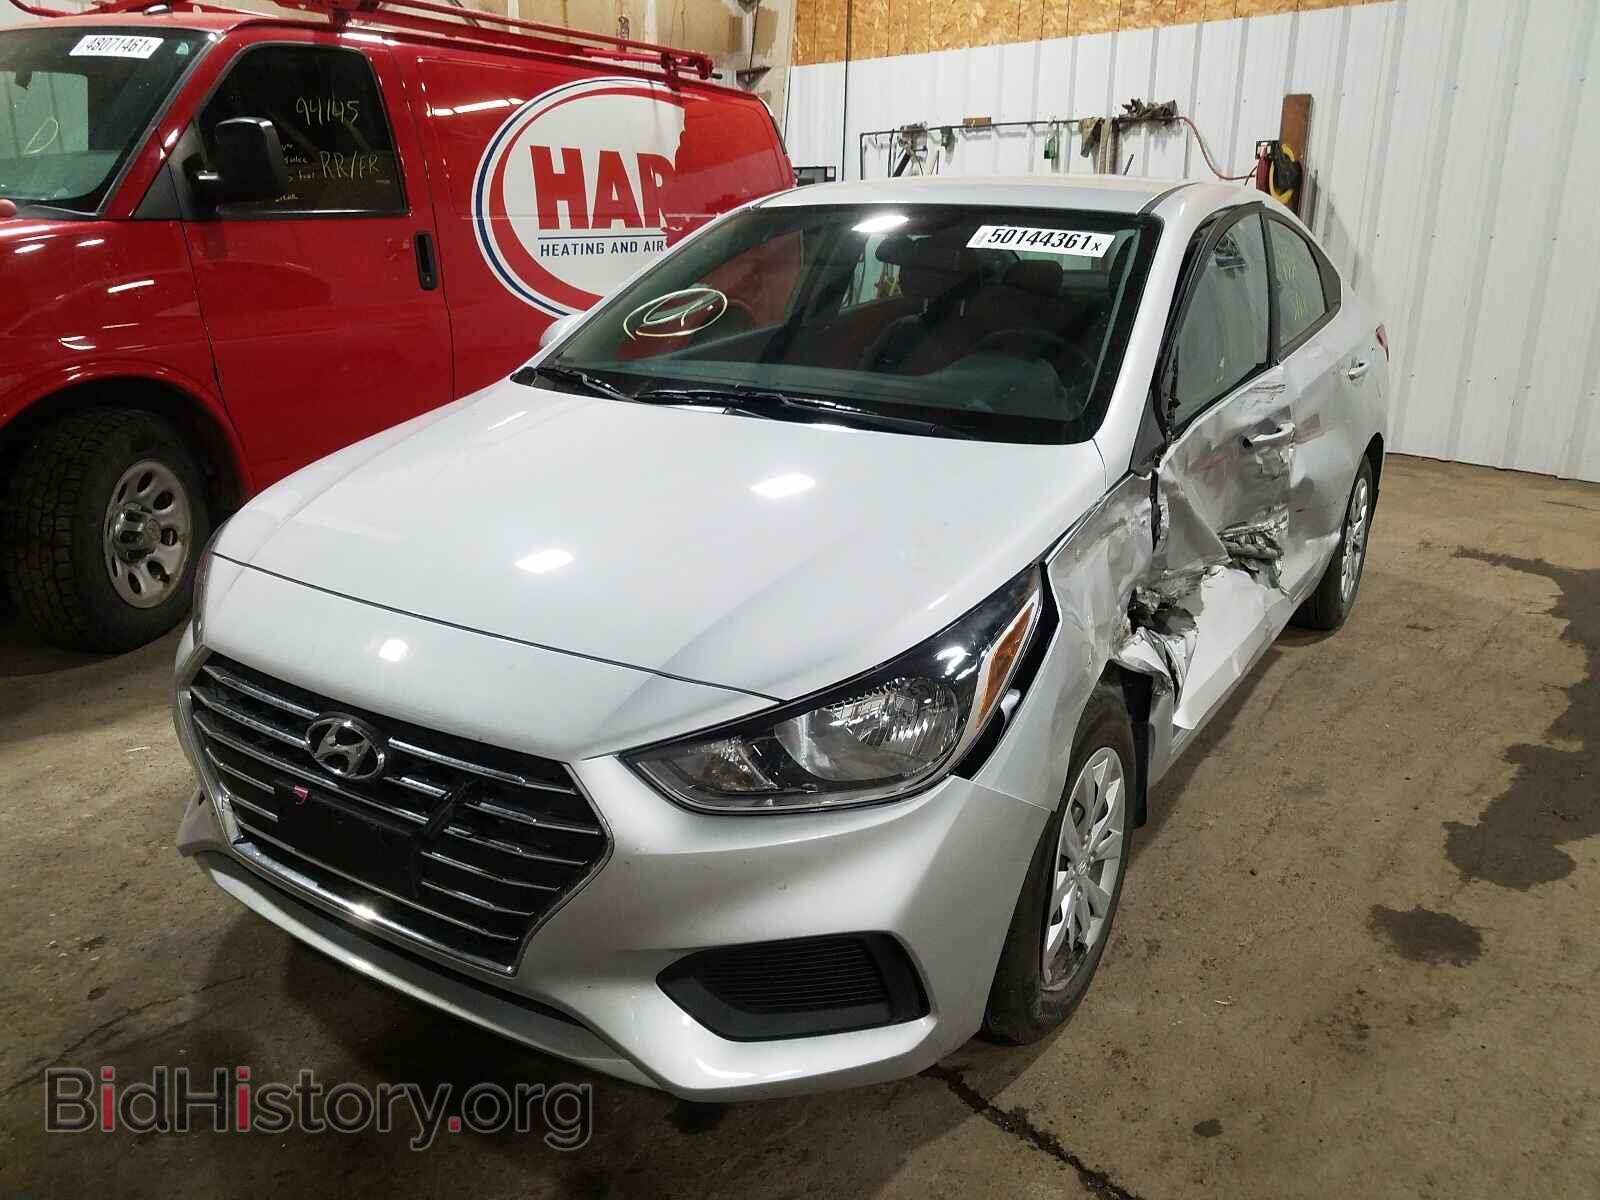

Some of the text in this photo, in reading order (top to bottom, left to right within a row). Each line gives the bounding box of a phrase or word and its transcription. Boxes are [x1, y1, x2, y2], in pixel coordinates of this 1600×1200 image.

[540, 240, 665, 257] HEATING AND AIR
